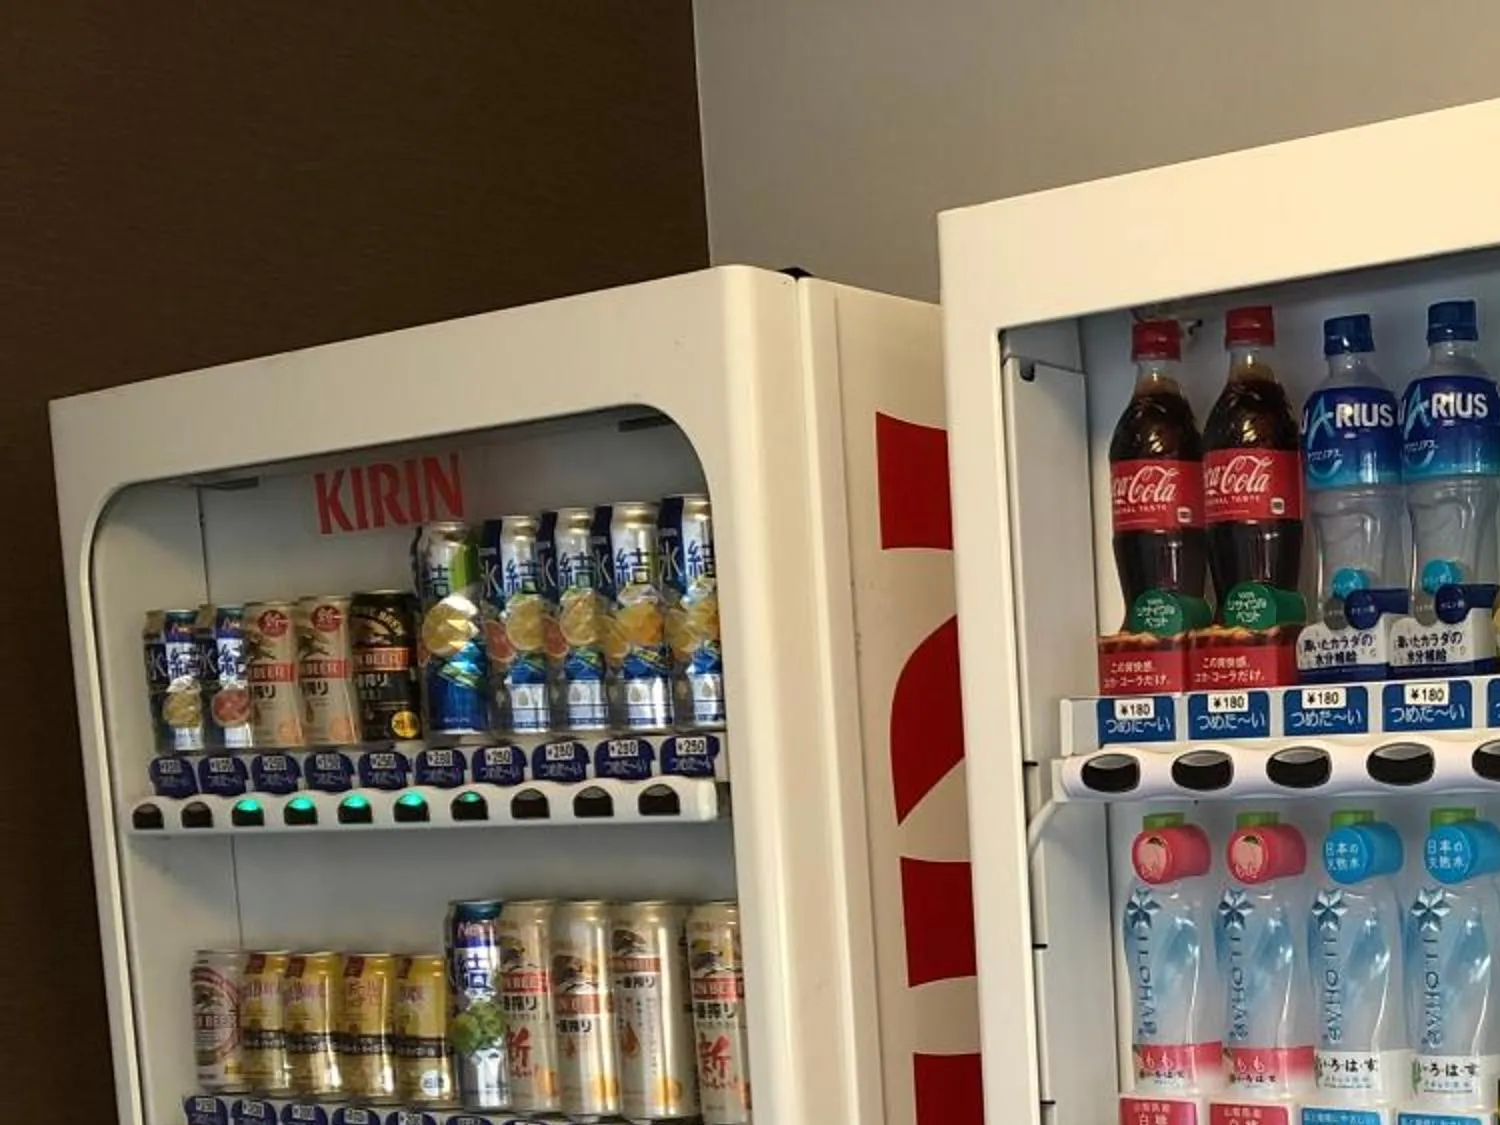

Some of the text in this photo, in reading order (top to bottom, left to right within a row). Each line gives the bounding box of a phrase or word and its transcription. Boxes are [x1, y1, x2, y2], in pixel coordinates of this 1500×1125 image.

[314, 454, 465, 536] KIRIN
[1307, 691, 1340, 705] ¥180
[1410, 688, 1445, 702] ¥180
[1121, 703, 1151, 716] ¥180
[1213, 696, 1245, 709] ¥180
[1325, 842, 1360, 858] 日本の
[1428, 839, 1464, 857] 日本の
